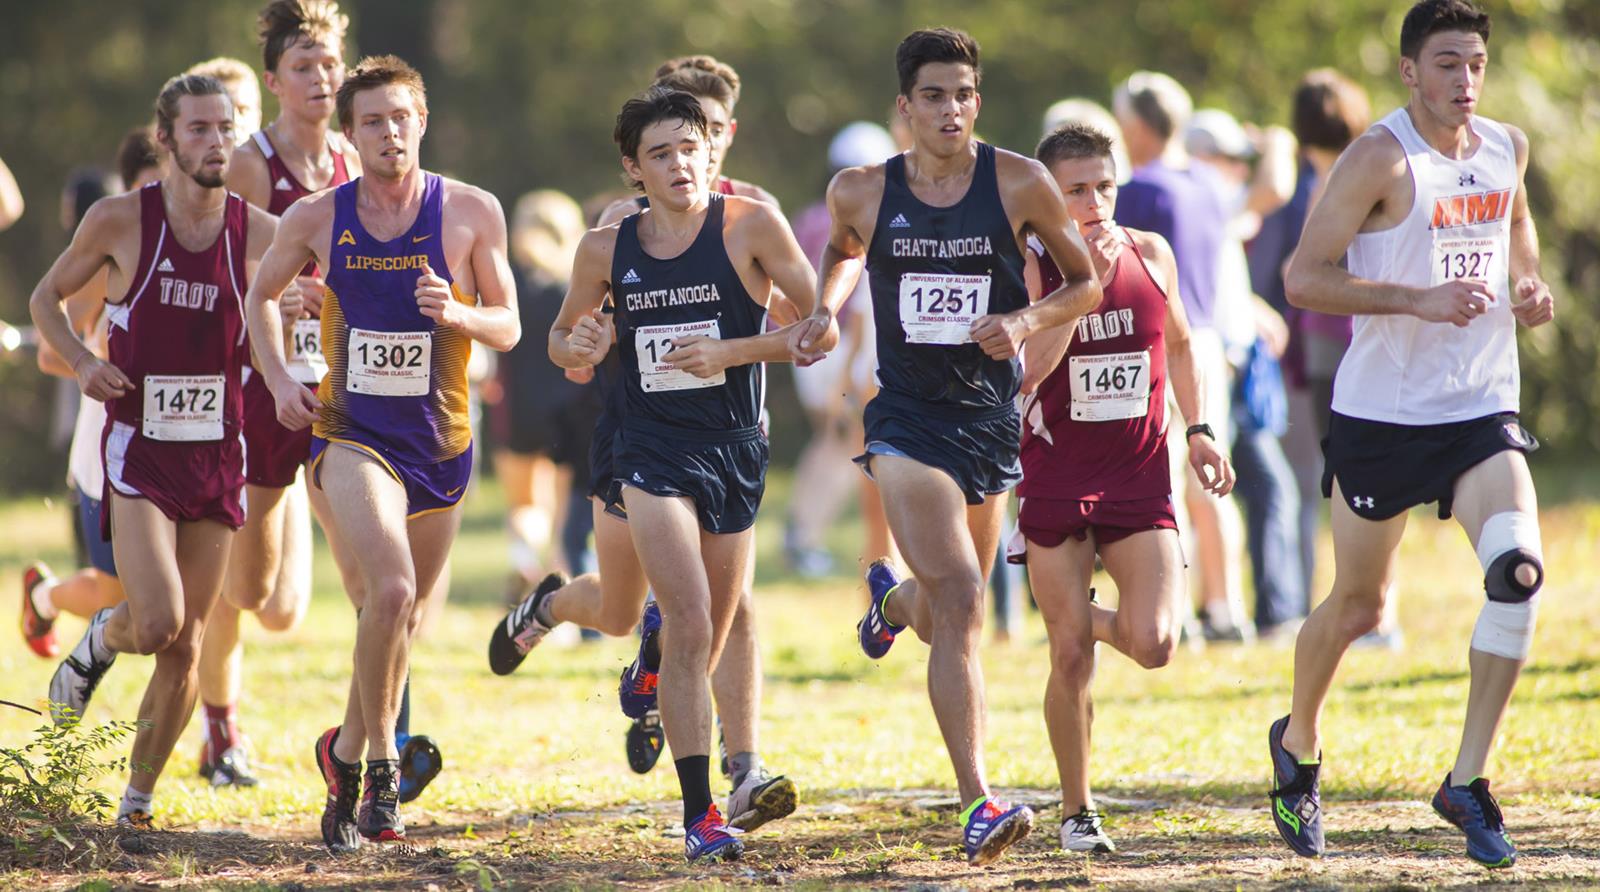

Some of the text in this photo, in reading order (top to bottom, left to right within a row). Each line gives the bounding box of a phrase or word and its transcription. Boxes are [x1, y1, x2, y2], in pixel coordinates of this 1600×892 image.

[1429, 188, 1511, 230] MMI
[893, 236, 993, 258] CHATTANOOGA
[1441, 252, 1493, 279] 1327
[910, 275, 943, 283] UNIVERSITY
[160, 277, 219, 312] TROY
[626, 283, 720, 312] CHATTANOOGA
[911, 287, 978, 314] 1251
[683, 322, 711, 332] ALABAMA
[918, 315, 945, 323] CRIMSON
[1077, 308, 1134, 343] TROY
[356, 331, 388, 340] UNIVERSITY
[358, 342, 423, 368] 1302
[1077, 356, 1109, 364] UNIVERSITY
[364, 368, 389, 376] CRIMSON
[655, 364, 673, 372] CRIMS
[1080, 365, 1142, 392] 1467
[154, 388, 217, 413] 1472
[1087, 393, 1112, 401] CRIMSON
